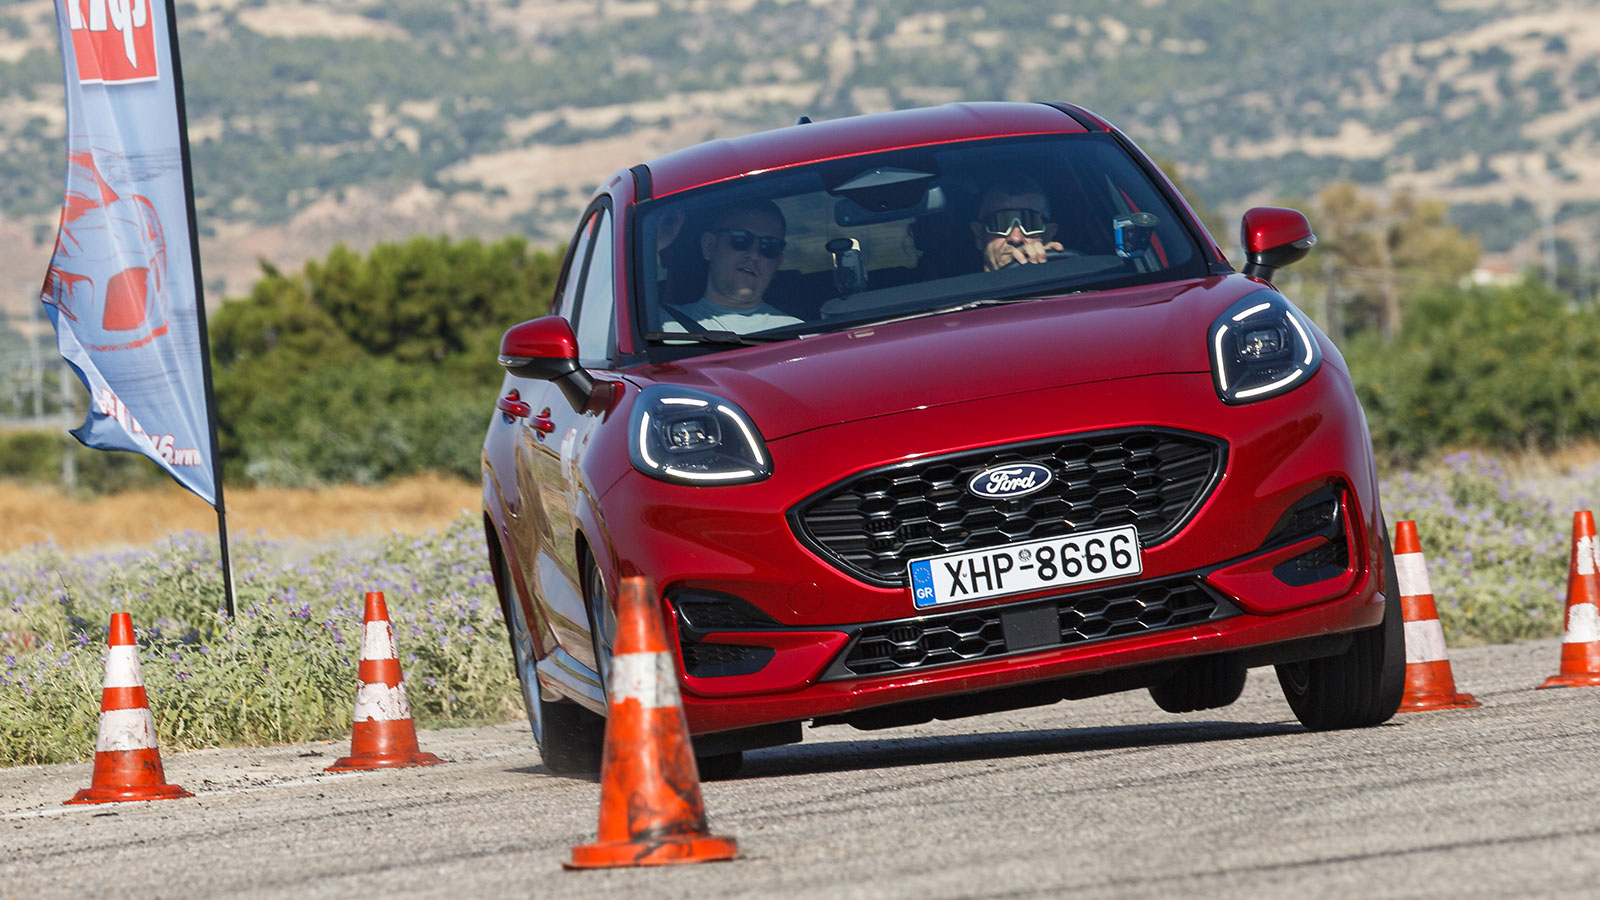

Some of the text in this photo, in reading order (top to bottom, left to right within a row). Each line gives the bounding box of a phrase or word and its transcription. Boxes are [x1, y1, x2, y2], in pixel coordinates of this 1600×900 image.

[985, 468, 1036, 494] Ford
[943, 534, 1132, 597] XHP-8666
[916, 586, 934, 600] GR
